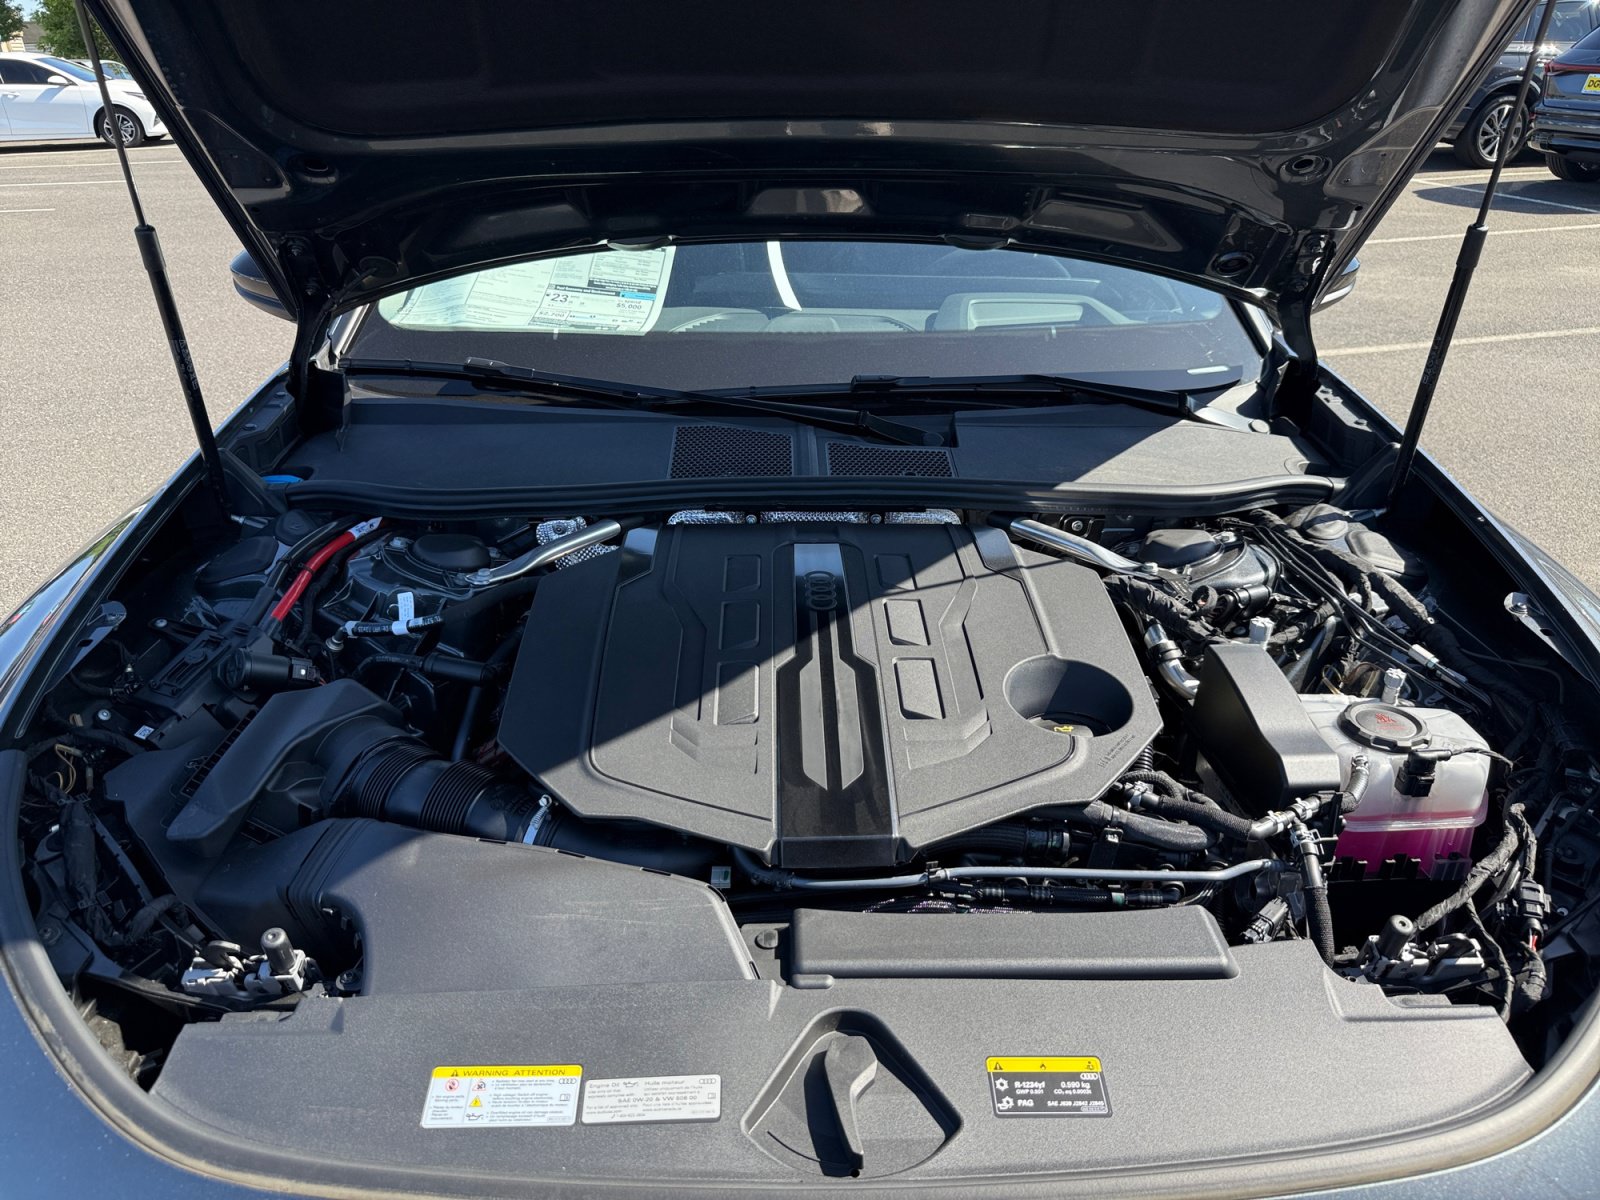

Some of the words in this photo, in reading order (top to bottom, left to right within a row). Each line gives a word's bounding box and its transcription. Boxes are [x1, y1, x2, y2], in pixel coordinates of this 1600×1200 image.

[550, 293, 569, 303] 23
[514, 1068, 566, 1076] ATTENTION
[1014, 1081, 1046, 1089] R-1234yf
[1081, 1081, 1091, 1089] kg
[1017, 1099, 1034, 1107] PAG
